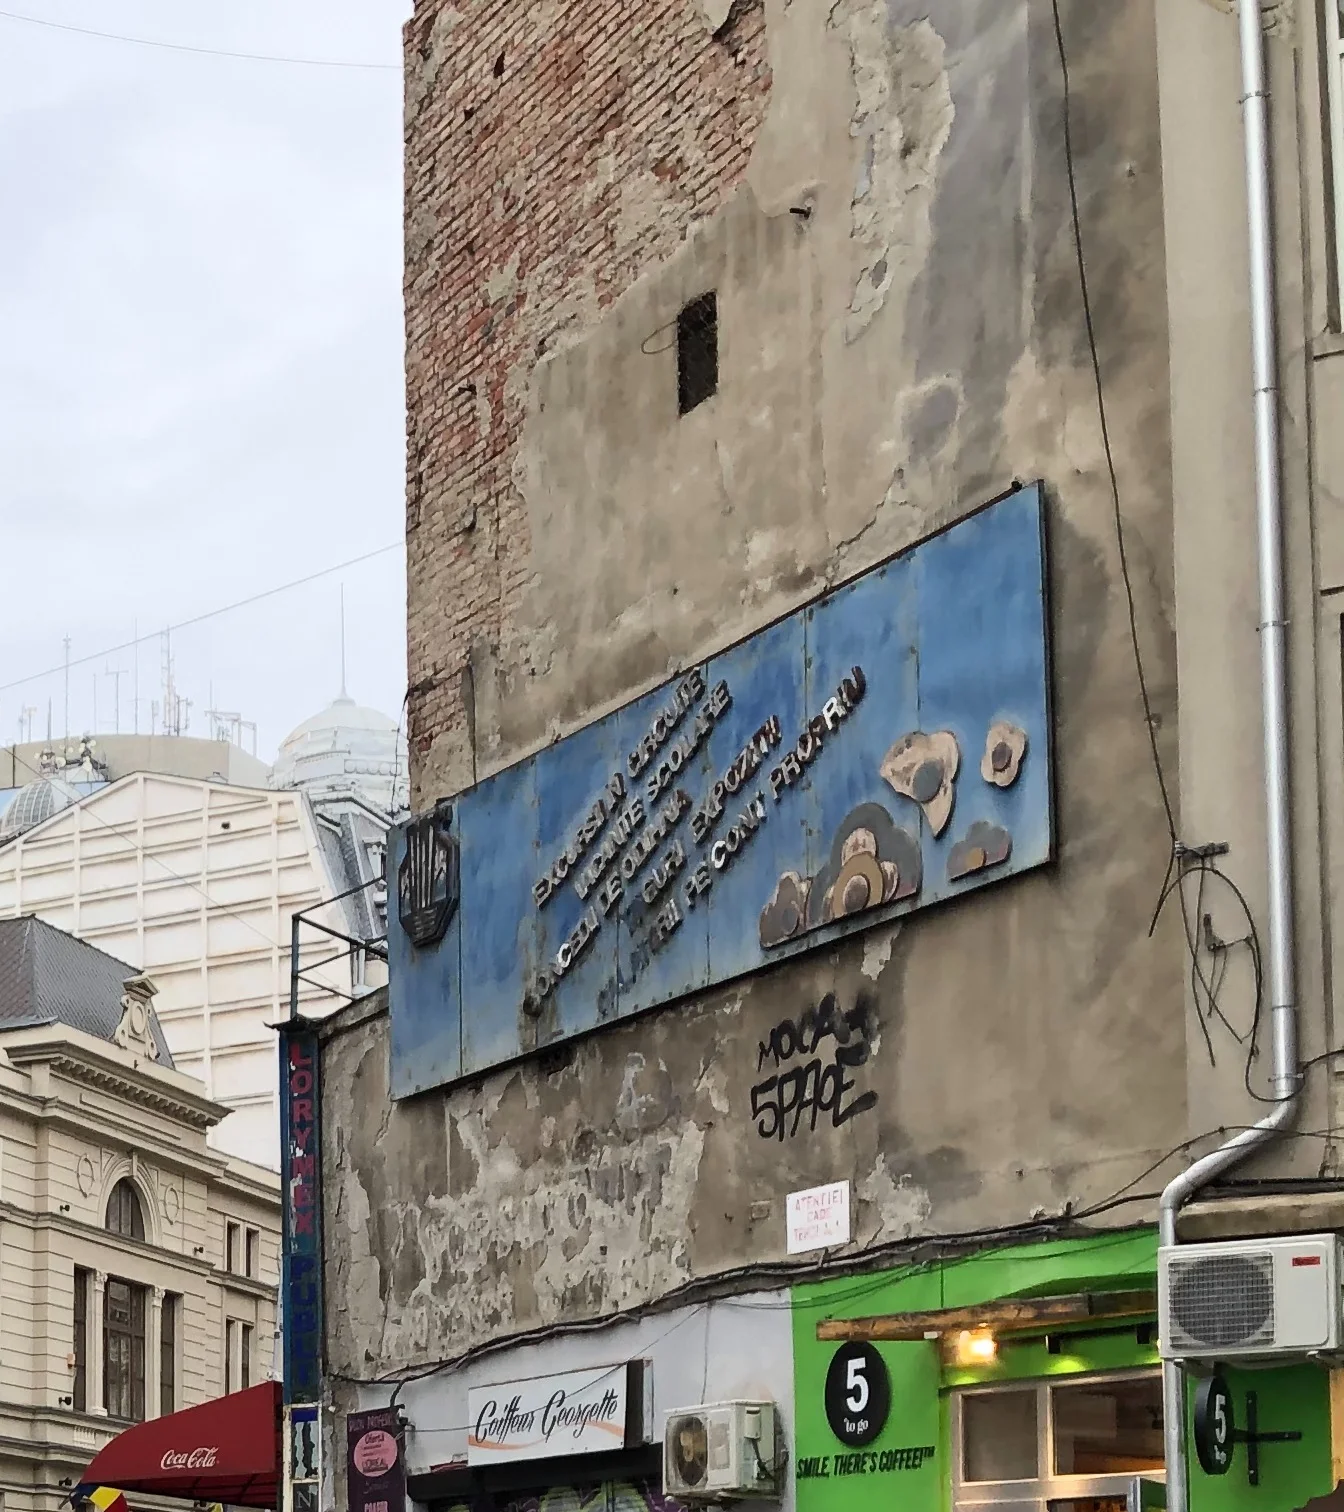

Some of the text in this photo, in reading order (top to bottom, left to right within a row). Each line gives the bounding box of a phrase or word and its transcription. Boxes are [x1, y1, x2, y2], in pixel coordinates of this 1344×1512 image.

[626, 667, 706, 779] CIRCUITE
[846, 1357, 869, 1412] 5
[541, 1388, 619, 1444] Georgette
[857, 1418, 869, 1434] go
[1215, 1393, 1227, 1444] 5
